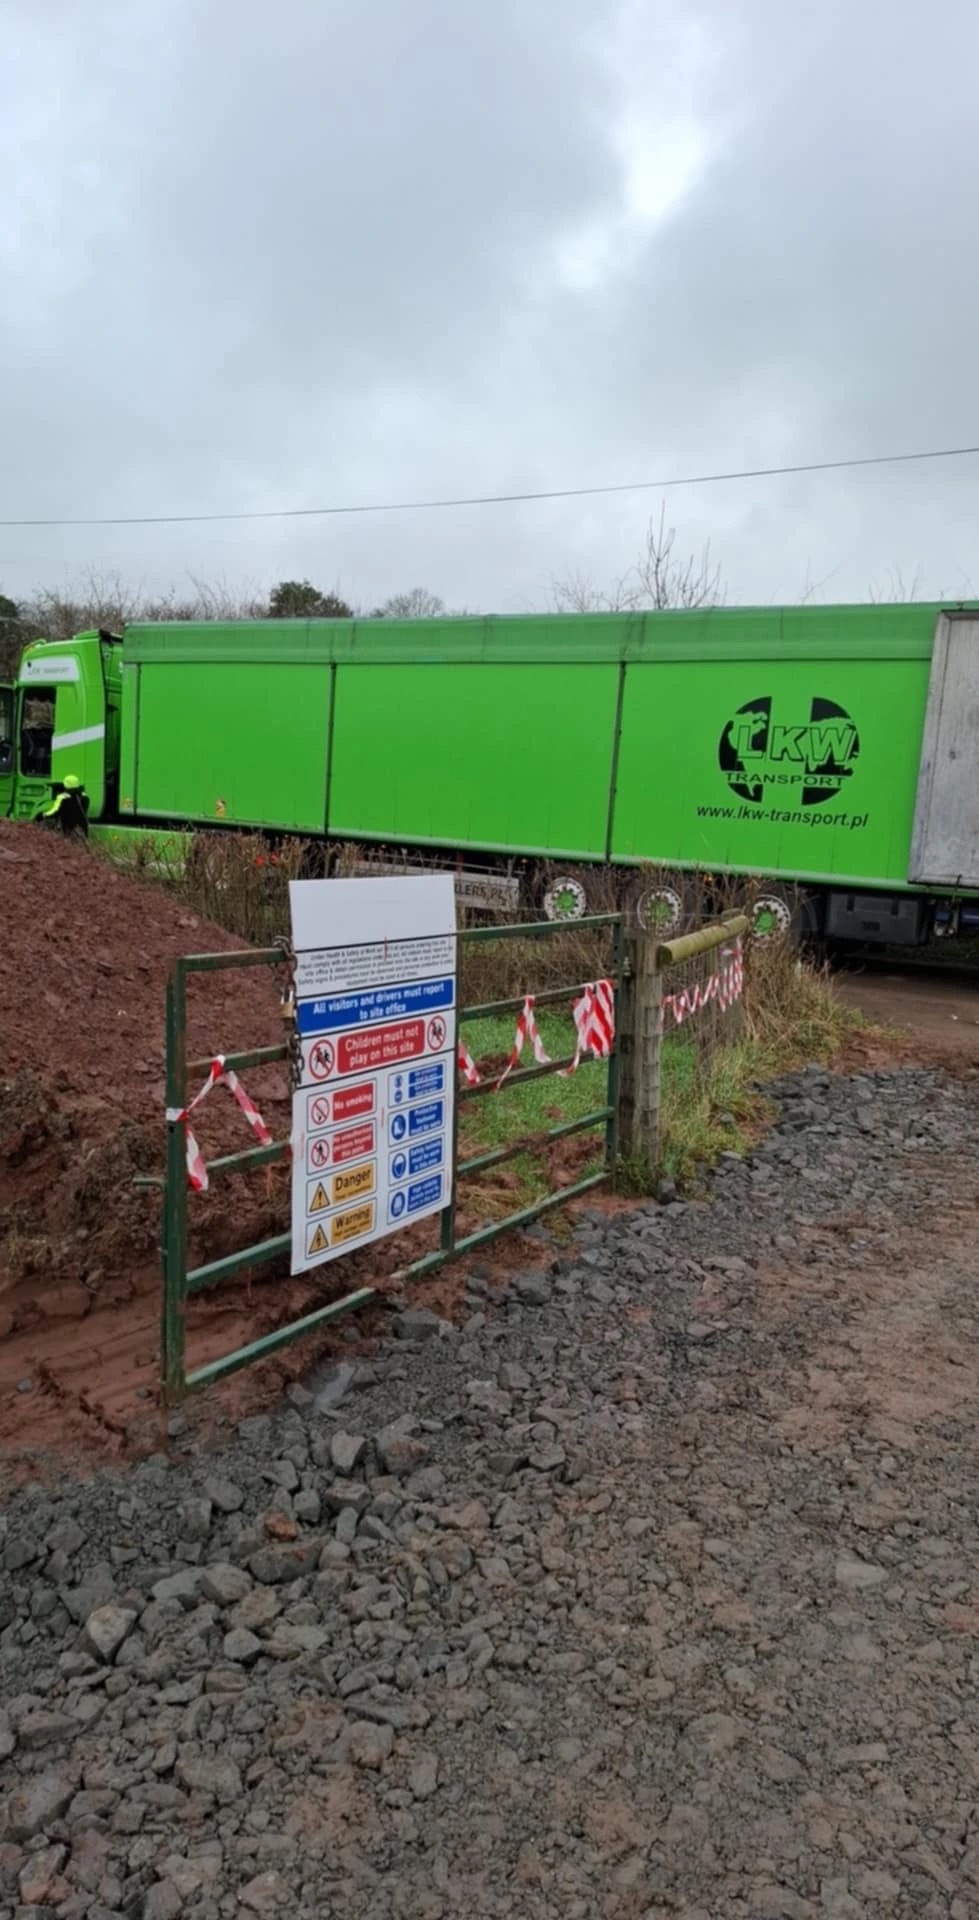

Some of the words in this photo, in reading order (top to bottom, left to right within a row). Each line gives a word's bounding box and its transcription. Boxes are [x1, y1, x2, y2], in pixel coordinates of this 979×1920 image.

[737, 725, 855, 762] LKW
[726, 772, 846, 787] TRANSPORT
[697, 805, 869, 829] www.lkw-transport.pl
[313, 1003, 327, 1014] All
[328, 999, 358, 1012] visitors
[360, 996, 374, 1007] and
[376, 990, 402, 1004] drivers
[404, 986, 422, 998] must
[423, 983, 444, 997] report
[359, 1010, 368, 1020] to
[370, 1007, 383, 1018] site
[385, 1003, 406, 1015] office
[345, 1033, 382, 1051] Children
[383, 1029, 403, 1043] must
[405, 1026, 419, 1038] not
[350, 1052, 368, 1066] play
[370, 1050, 381, 1061] on
[383, 1045, 398, 1058] this
[399, 1041, 414, 1054] site
[336, 1169, 371, 1191] Danger
[336, 1207, 370, 1229] Warning
